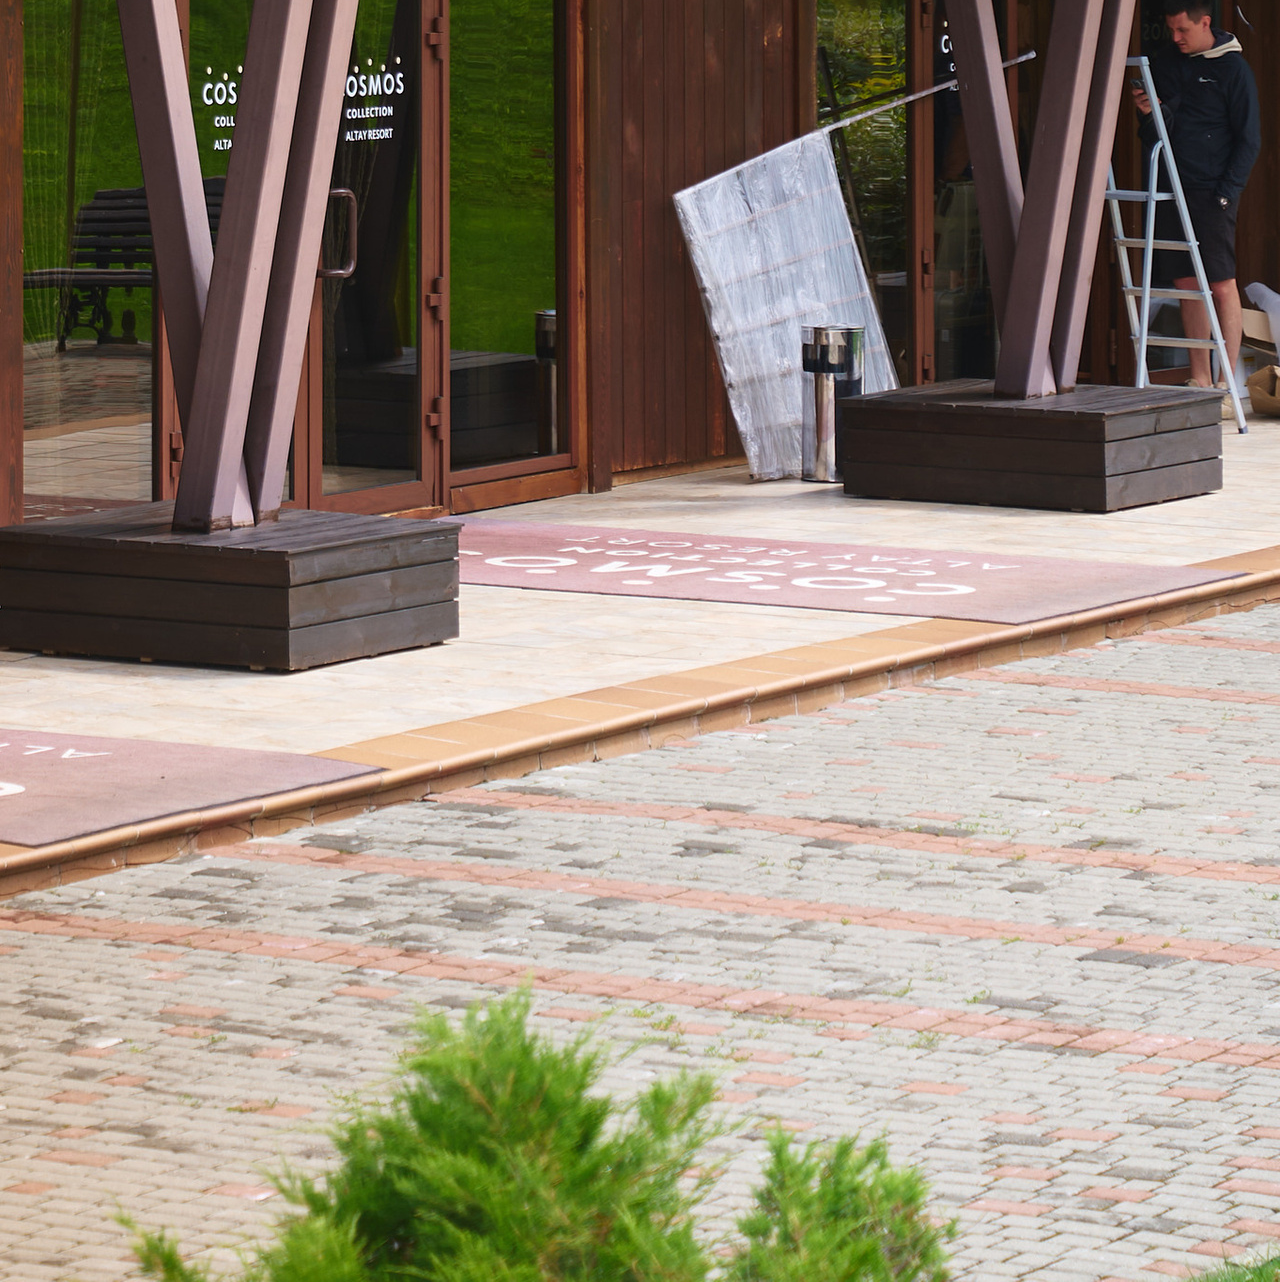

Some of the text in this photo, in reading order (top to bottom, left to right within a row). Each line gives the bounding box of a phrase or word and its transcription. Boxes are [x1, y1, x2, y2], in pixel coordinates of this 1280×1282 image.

[342, 72, 405, 98] OSMOS
[346, 105, 394, 120] COLLECTION
[345, 127, 394, 142] ALTAY RESORT
[556, 546, 937, 577] COLLECTION
[564, 536, 1022, 571] ALTAY RESORT
[459, 549, 977, 596] COSMO
